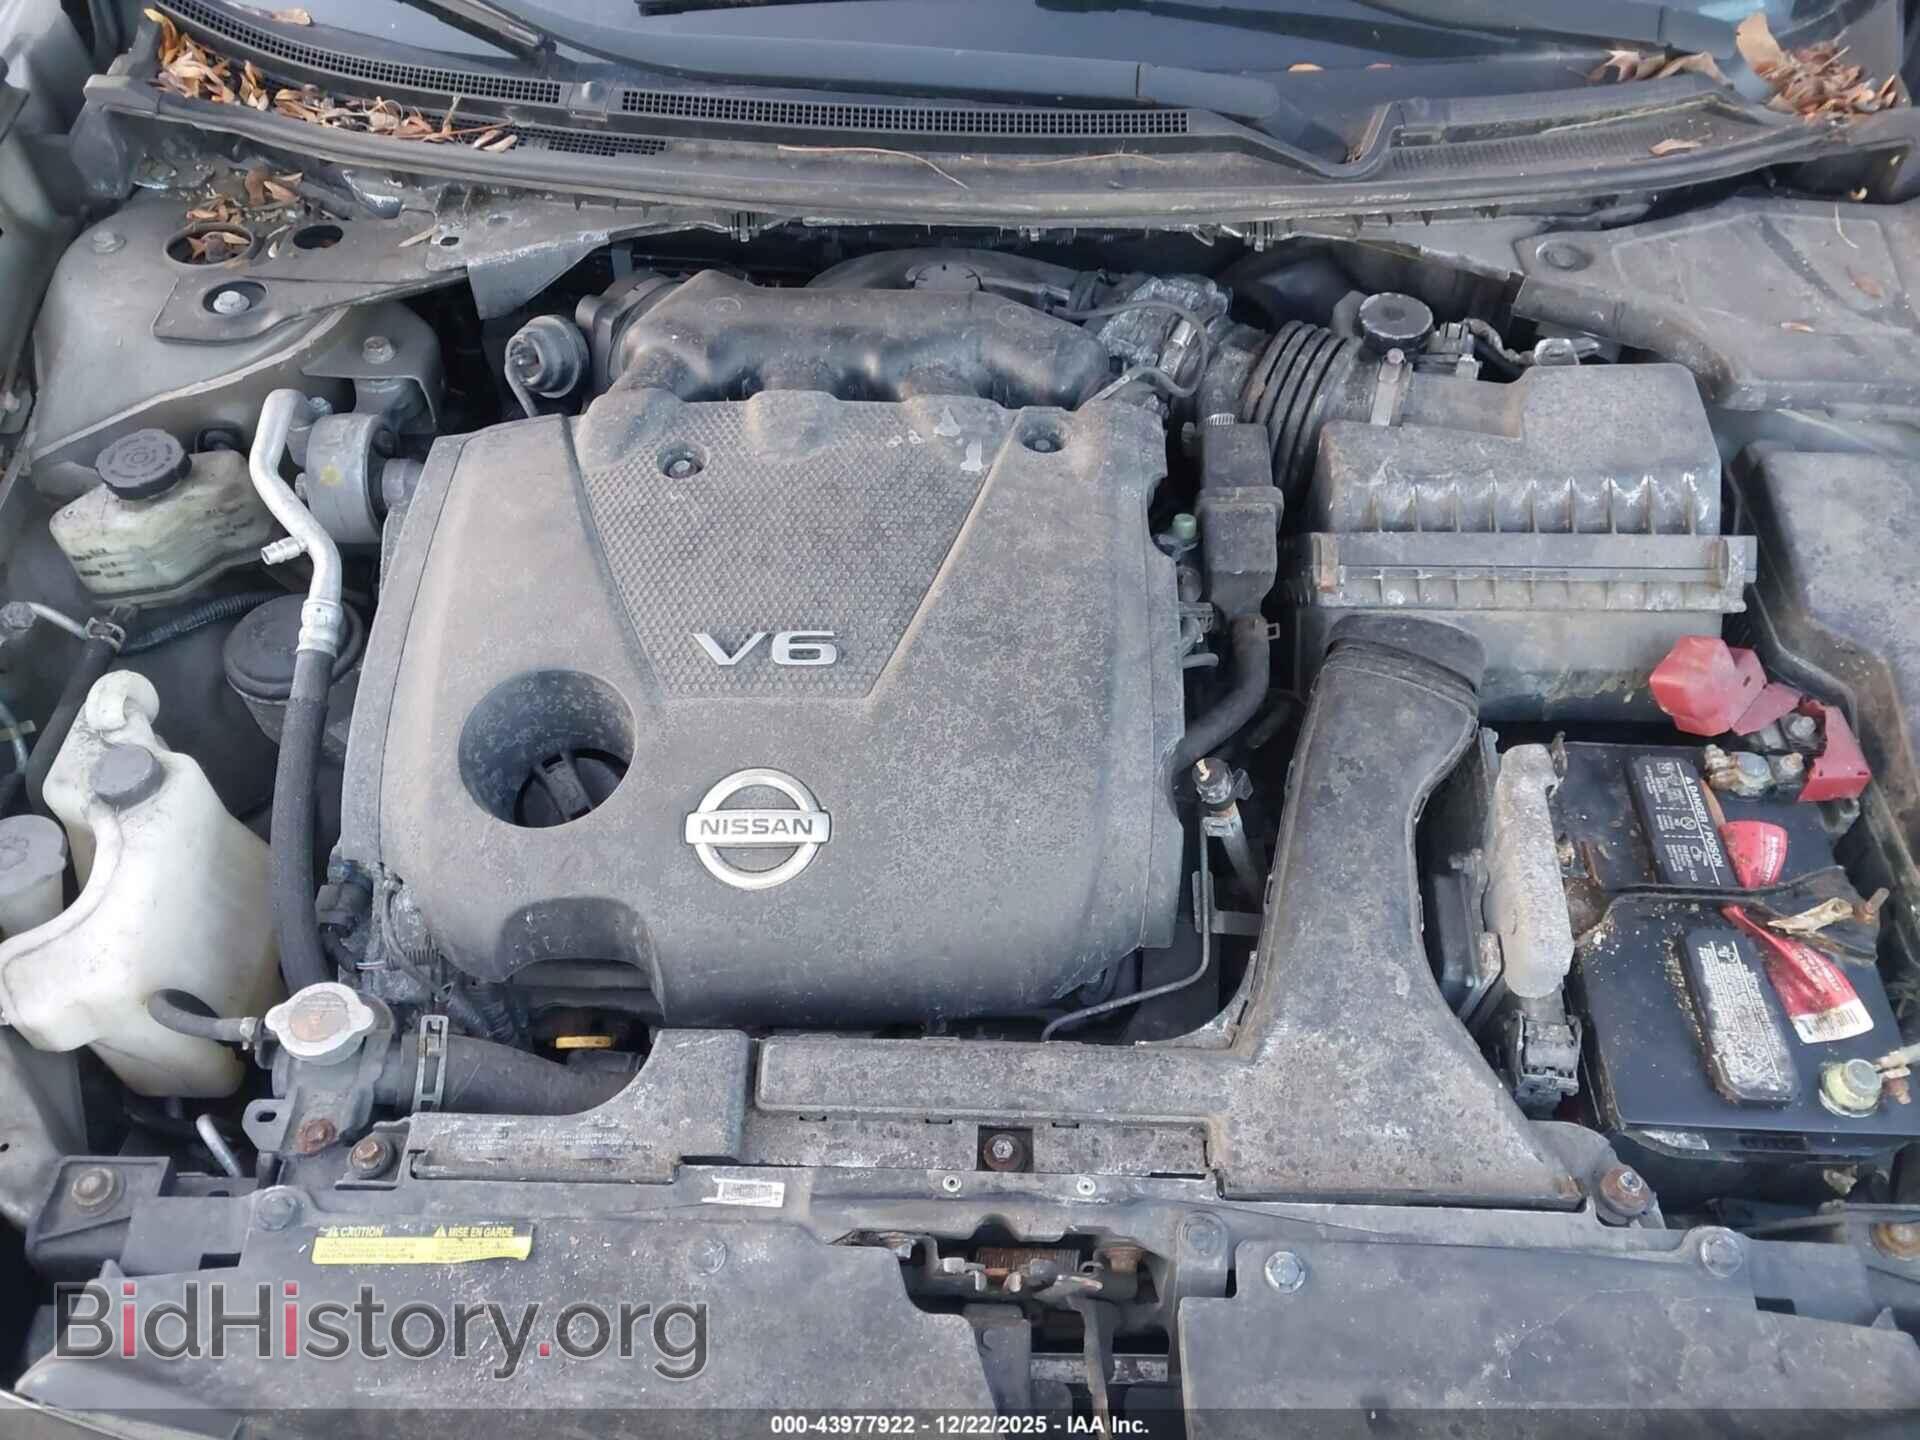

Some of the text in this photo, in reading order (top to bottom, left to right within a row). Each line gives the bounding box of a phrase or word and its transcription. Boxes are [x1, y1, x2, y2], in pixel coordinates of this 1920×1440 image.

[692, 630, 838, 666] V6
[699, 817, 814, 836] NISSAN
[1689, 784, 1709, 823] DANGER
[1703, 831, 1725, 868] POISON
[340, 1224, 385, 1238] CAUTION
[483, 1226, 515, 1238] GARDE
